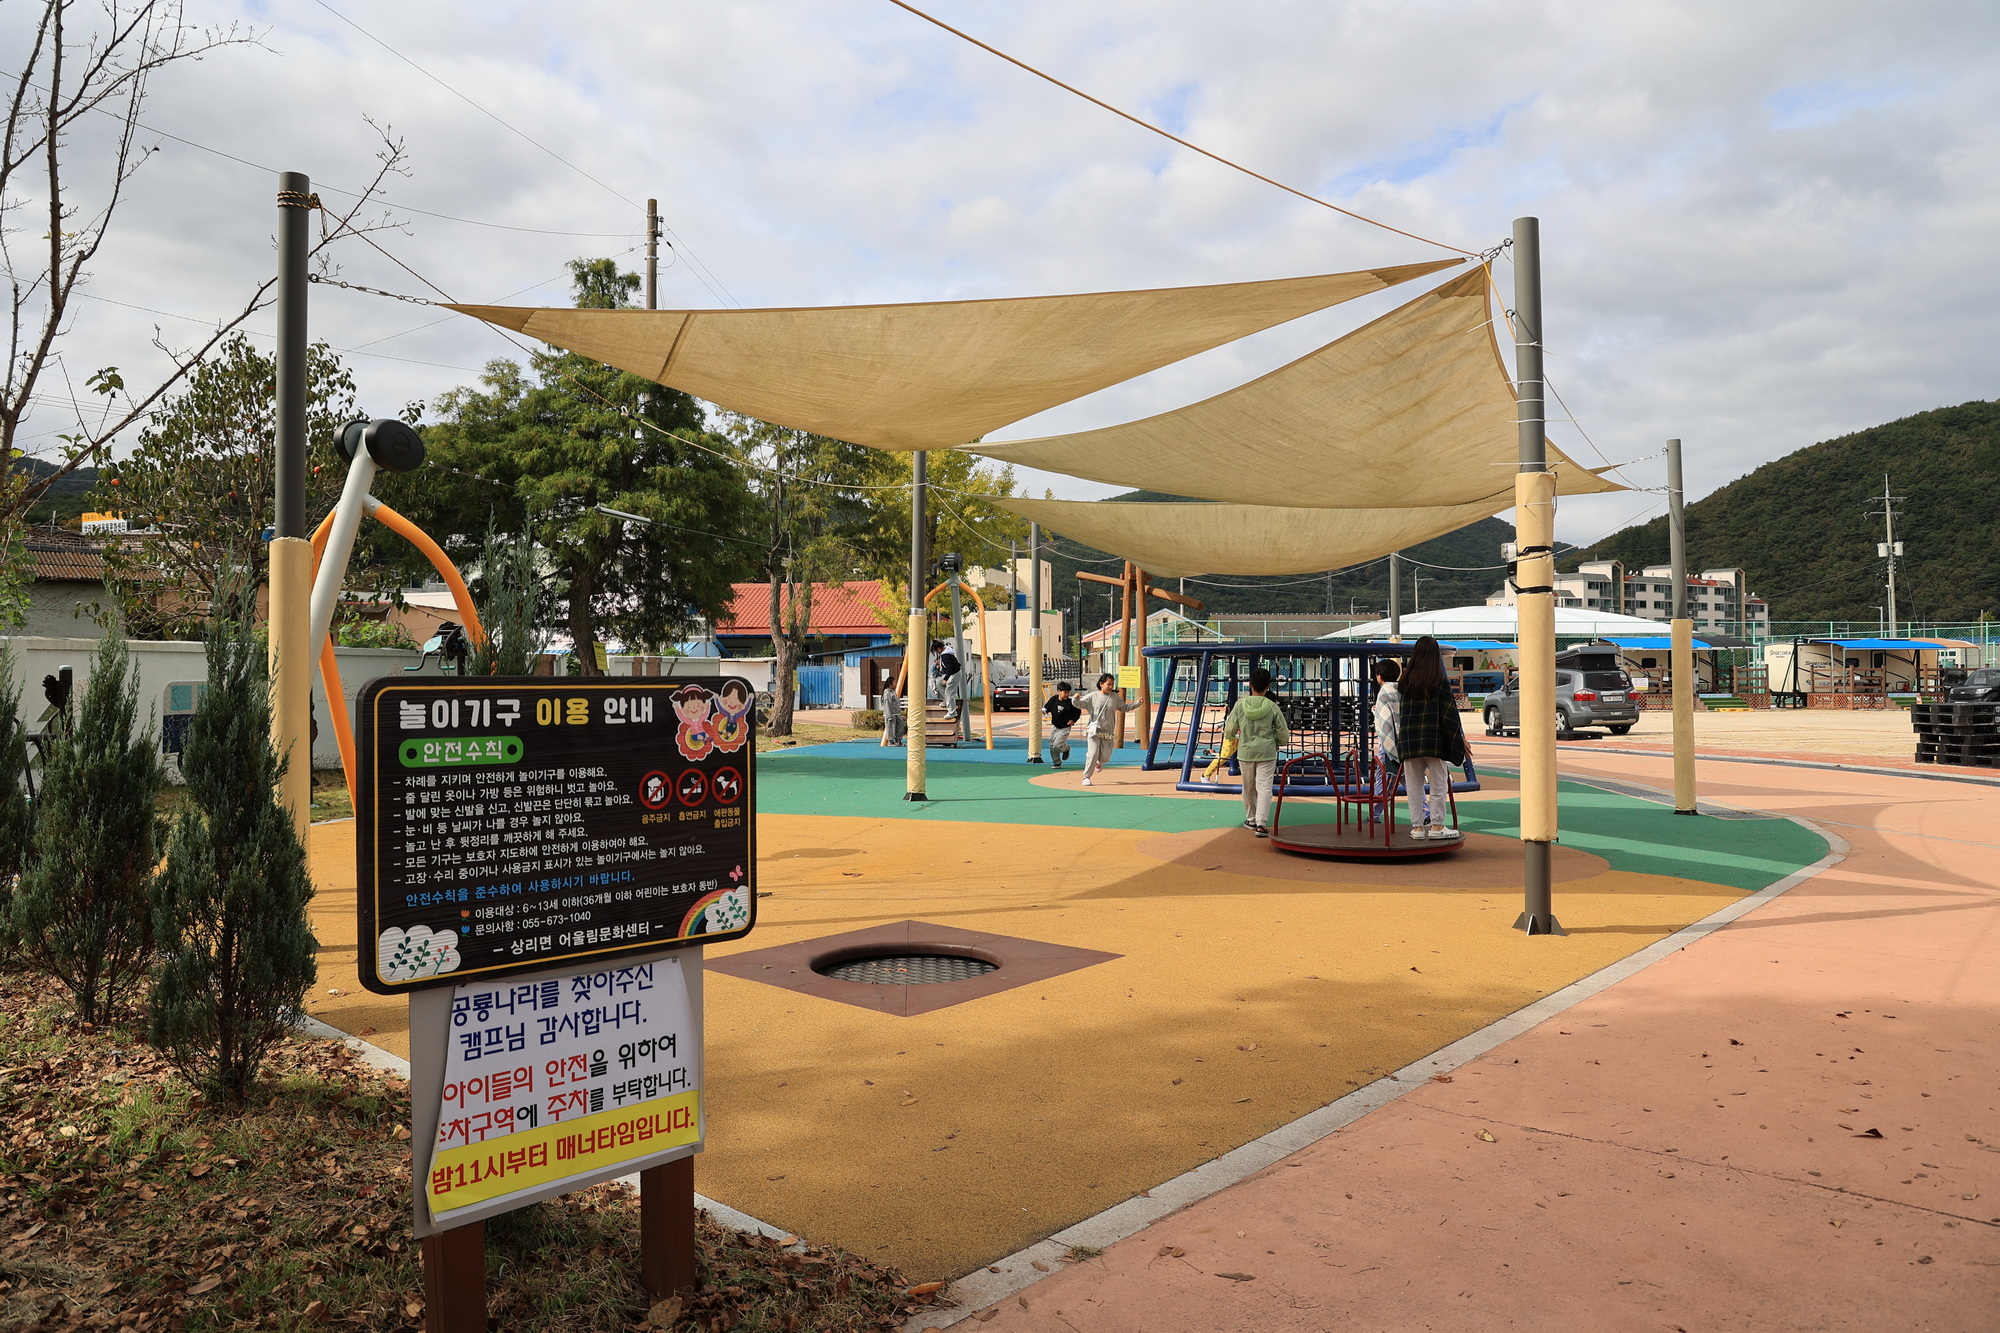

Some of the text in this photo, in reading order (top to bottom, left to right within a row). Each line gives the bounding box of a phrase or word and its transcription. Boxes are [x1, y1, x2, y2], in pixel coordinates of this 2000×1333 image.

[399, 697, 653, 729] 놀이기구 이용 안내
[423, 740, 502, 763] 안전수칙
[405, 767, 607, 788] 차례를 지키며 안전하게 놀이기구를 이용해요.
[405, 781, 618, 804] 줄 달린 옷이나 가방 등은 위험하니 벗고 놀아요.
[405, 794, 633, 820] 발에 맞는 신발을 신고, 신발끈은 단단히 묶고 놀아요.
[436, 822, 448, 834] 등
[451, 820, 482, 833] 날씨가
[486, 819, 505, 830] 나쁠
[510, 816, 529, 828] 경우
[532, 814, 551, 827] 놀지
[554, 812, 585, 825] 않아요.
[641, 813, 671, 824] 음주금지
[678, 810, 706, 821] 흡연금지
[713, 807, 740, 817] 애완동물
[714, 817, 740, 828] 출입금지
[405, 827, 588, 853] 놀고 난 후 뒷정리를 깨끗하게 해 주세요.
[405, 836, 649, 868] 모든 기구는 보호자 지도하에 안전하게 이용하여야 해요.
[458, 864, 498, 879] 중이거나
[502, 860, 541, 874] 사용금지
[544, 857, 572, 870] 표시가
[575, 856, 593, 867] 있는
[596, 849, 656, 865] 놀이기구에서는
[659, 846, 676, 857] 놀지
[679, 844, 706, 857] 않아요.
[406, 870, 635, 907] 안전수칙을 준수하여 사용하시기 바랍니다.
[475, 904, 514, 919] 이용대상
[615, 890, 632, 902] 이하
[635, 886, 669, 899] 어린이는
[672, 882, 696, 894] 보호자
[699, 879, 718, 892] 동반)
[475, 920, 514, 936] 문의사항
[522, 911, 592, 929] 055-673-1040
[510, 921, 650, 955] 상리면 어울림문화센터
[453, 963, 653, 1026] 공룡나라를 찾아주신
[460, 1000, 647, 1061] 캠프님 감사합니다.
[443, 1033, 676, 1109] 아이들의 안전을 위하여
[547, 1087, 604, 1121] 주차를
[612, 1067, 691, 1105] 부탁합니다.
[432, 1106, 695, 1195] 밤11시부터 매너타임입니다.
